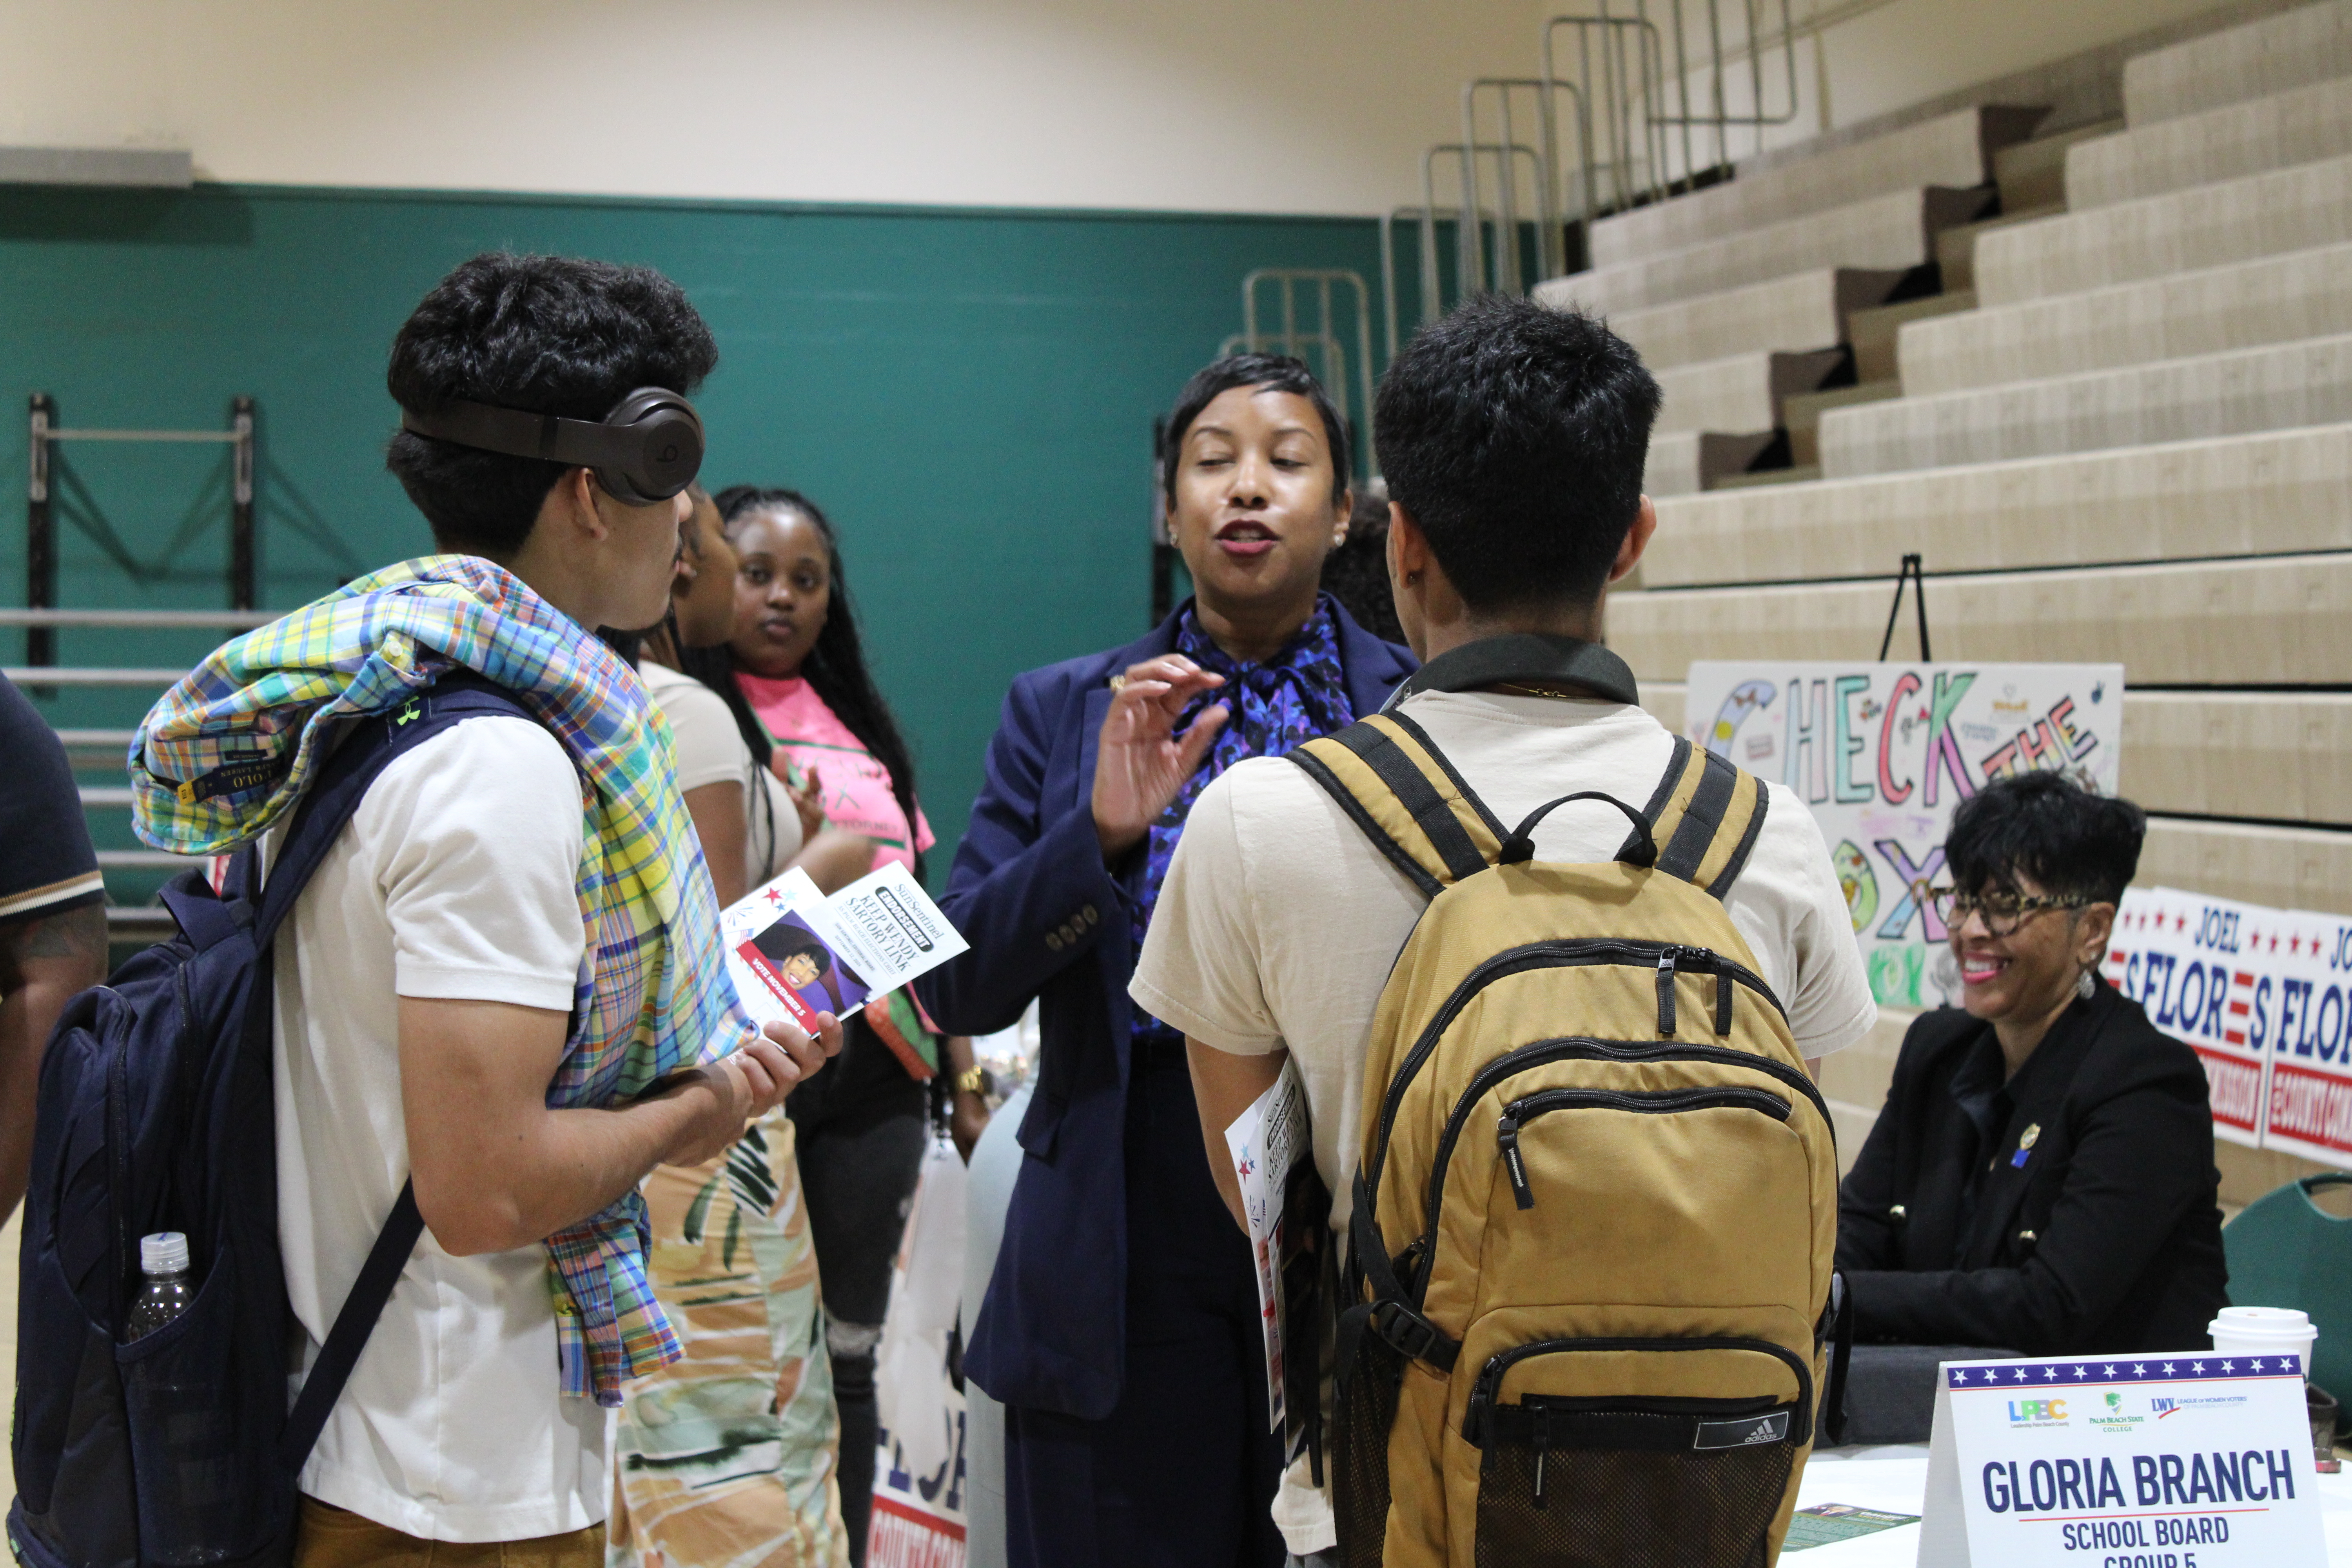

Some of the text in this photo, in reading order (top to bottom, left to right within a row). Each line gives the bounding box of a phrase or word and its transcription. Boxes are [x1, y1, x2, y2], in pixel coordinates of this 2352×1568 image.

[1706, 671, 1979, 808] CHECK
[1980, 694, 2099, 778] THE
[221, 767, 251, 777] LAUREN
[845, 897, 911, 972] SARTORY LINK
[859, 895, 919, 961] KEEP WENDY
[878, 890, 930, 948] ENDORSEMENT
[894, 884, 944, 939] SunSentinel
[2195, 906, 2240, 954] JOEL
[852, 924, 866, 938] BEACH
[864, 938, 885, 962] ELECTIONS
[883, 962, 897, 975] CHIEF
[752, 957, 771, 977] VOTE
[767, 975, 801, 1012] NOVEMBER
[2143, 951, 2272, 1049] FLORES
[2008, 1399, 2069, 1421] LPBC
[2151, 1398, 2175, 1412] LWV
[1745, 1433, 1778, 1443] adidas
[1982, 1449, 2295, 1513] GLORIA BRANCH
[2063, 1517, 2229, 1550] SCHOOL BOARD
